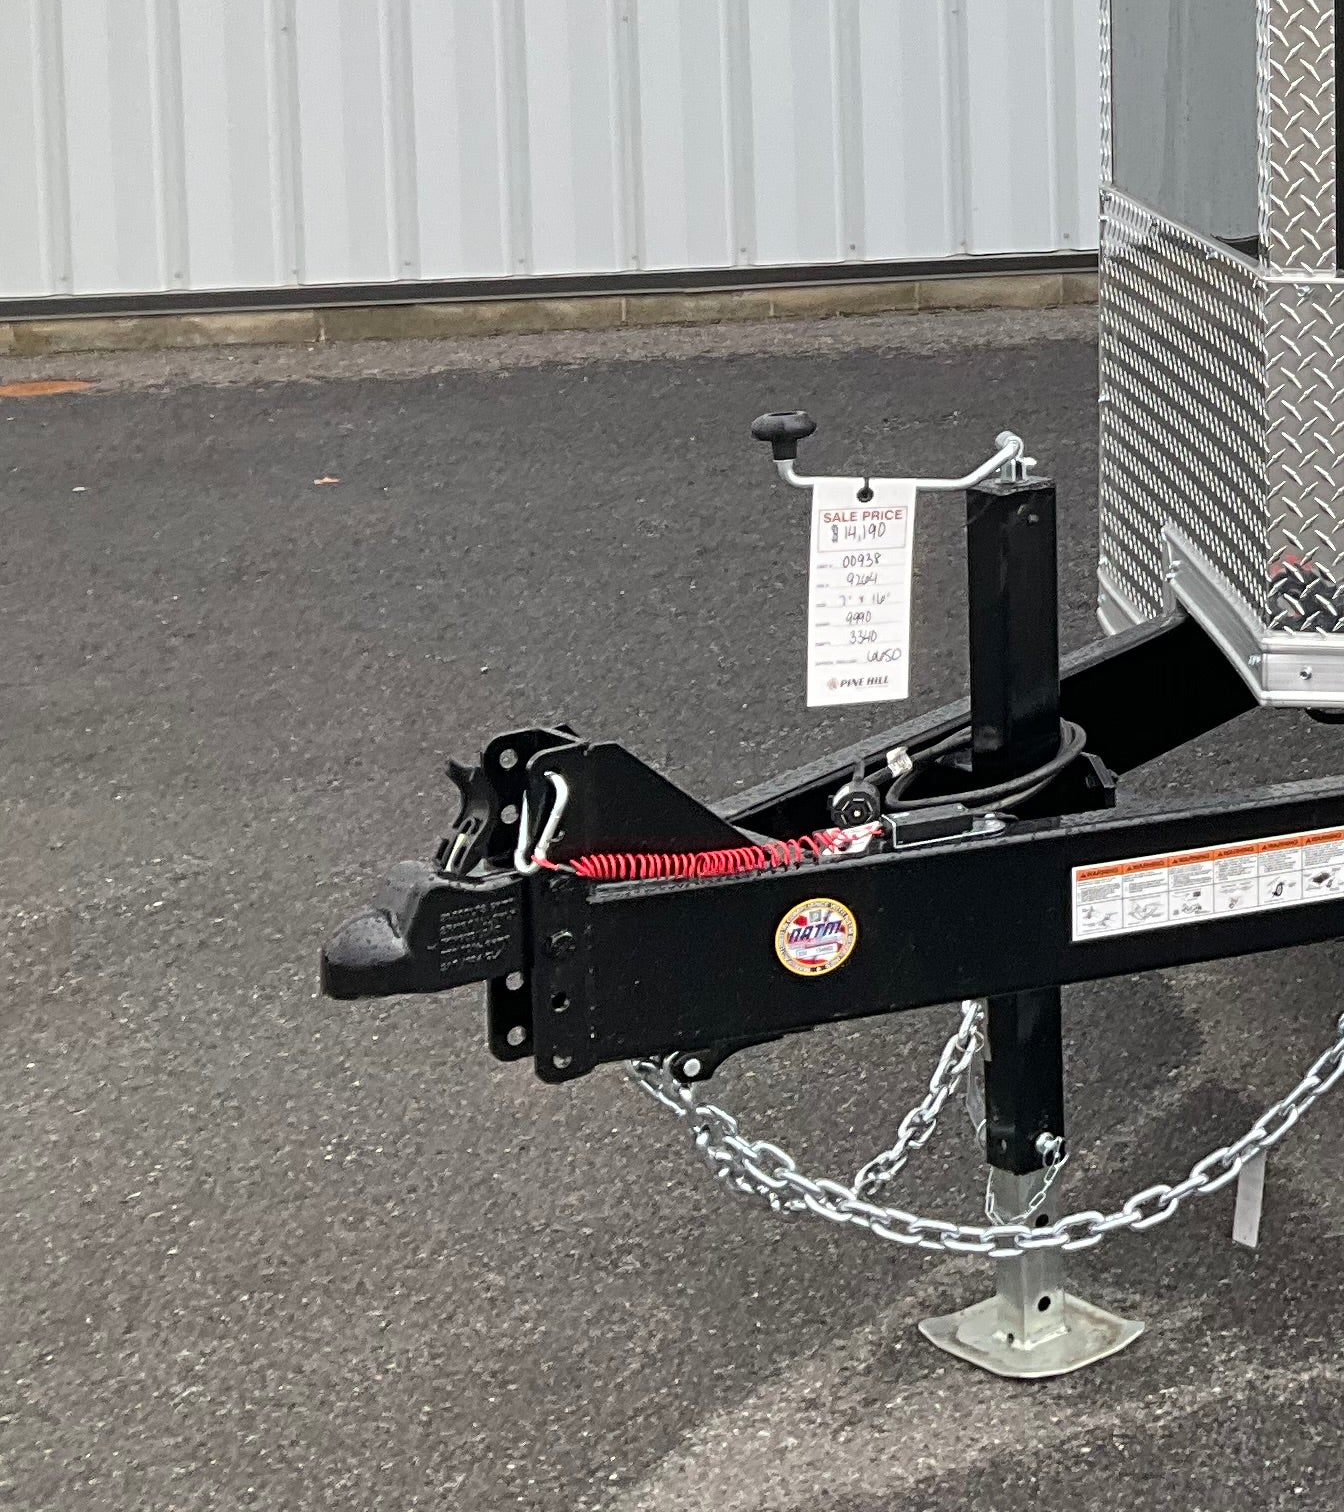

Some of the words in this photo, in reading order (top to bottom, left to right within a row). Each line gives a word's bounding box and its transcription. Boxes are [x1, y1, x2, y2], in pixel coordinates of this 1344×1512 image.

[823, 512, 857, 523] SALE
[862, 509, 903, 521] PRICE
[844, 521, 886, 542] 14,190
[842, 552, 881, 568] 00938
[849, 629, 878, 645] 3340
[840, 677, 865, 688] PINE
[866, 675, 889, 685] HILL
